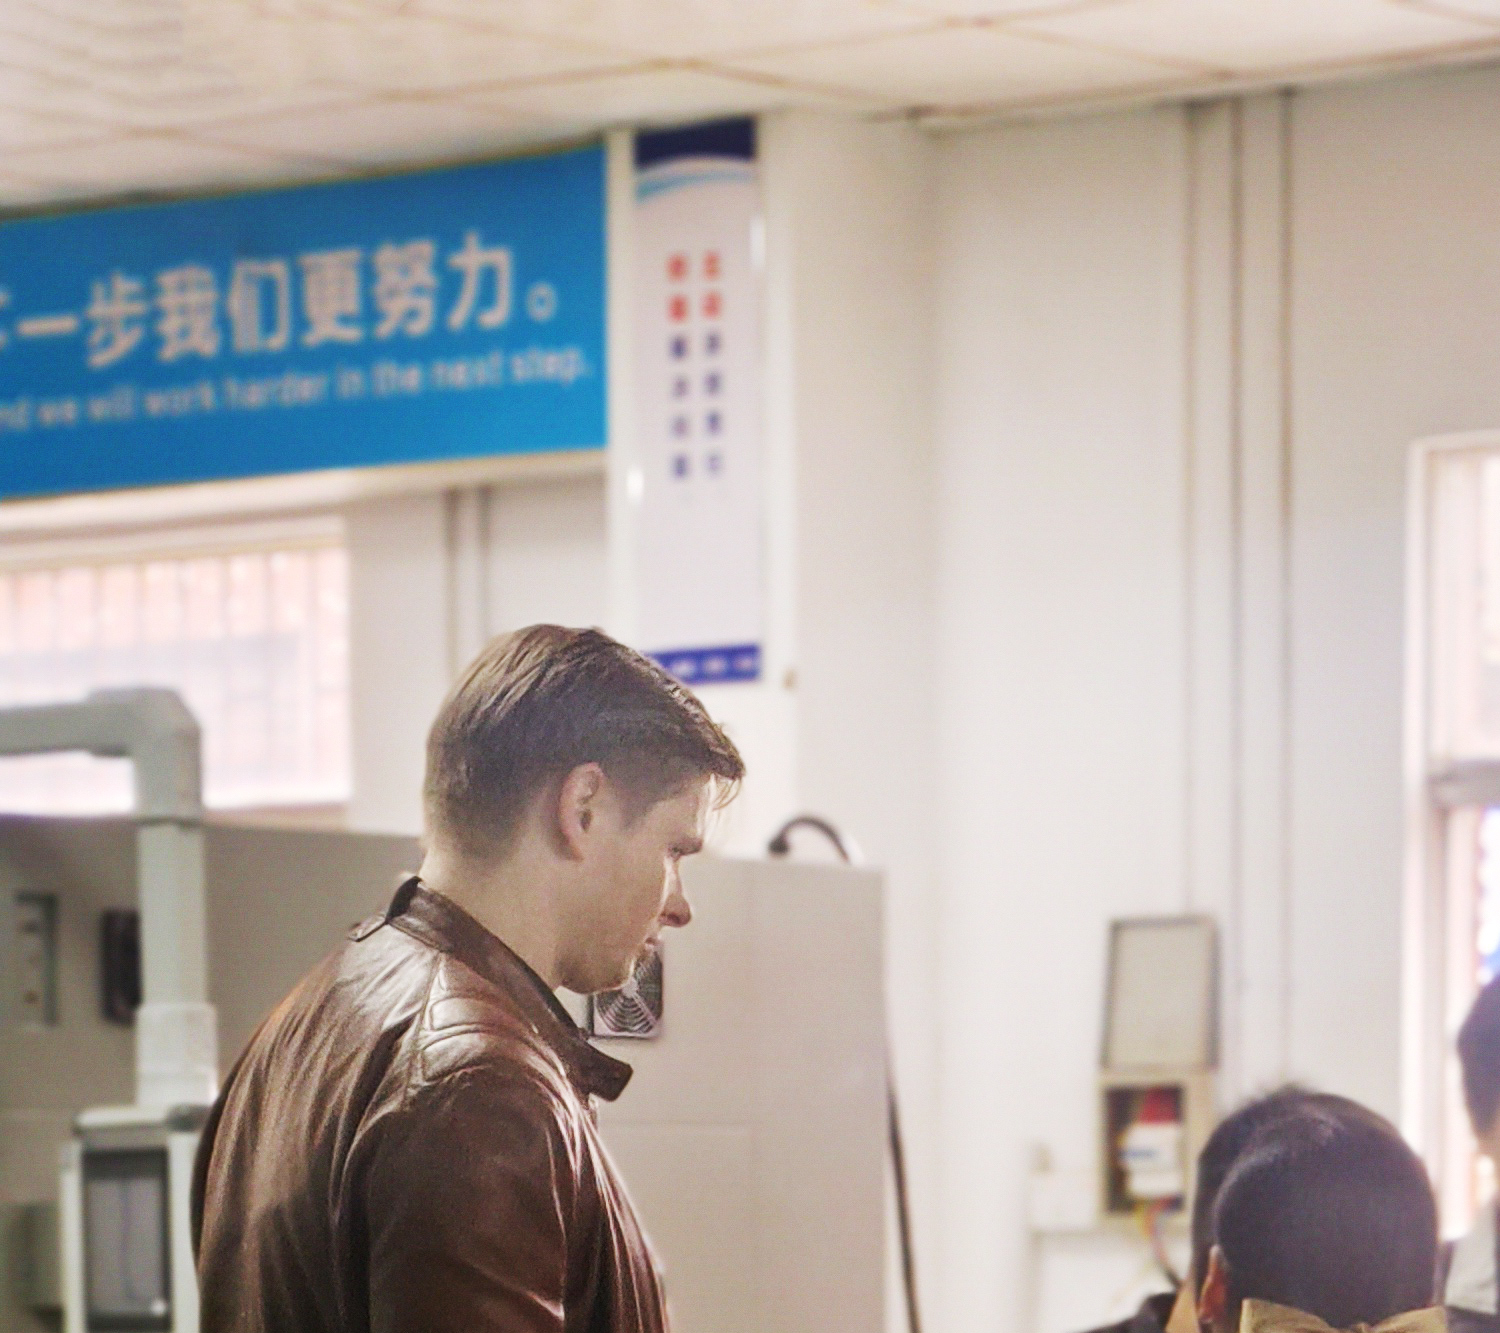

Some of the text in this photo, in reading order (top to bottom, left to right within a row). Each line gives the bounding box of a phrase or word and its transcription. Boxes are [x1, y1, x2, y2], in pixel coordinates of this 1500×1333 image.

[0, 231, 557, 368] 一步我们更努力。
[37, 396, 78, 428] we
[87, 382, 136, 423] will
[144, 379, 216, 418] work
[222, 368, 327, 410] harder
[335, 364, 365, 398] in
[370, 357, 421, 396] the
[430, 350, 502, 389] next
